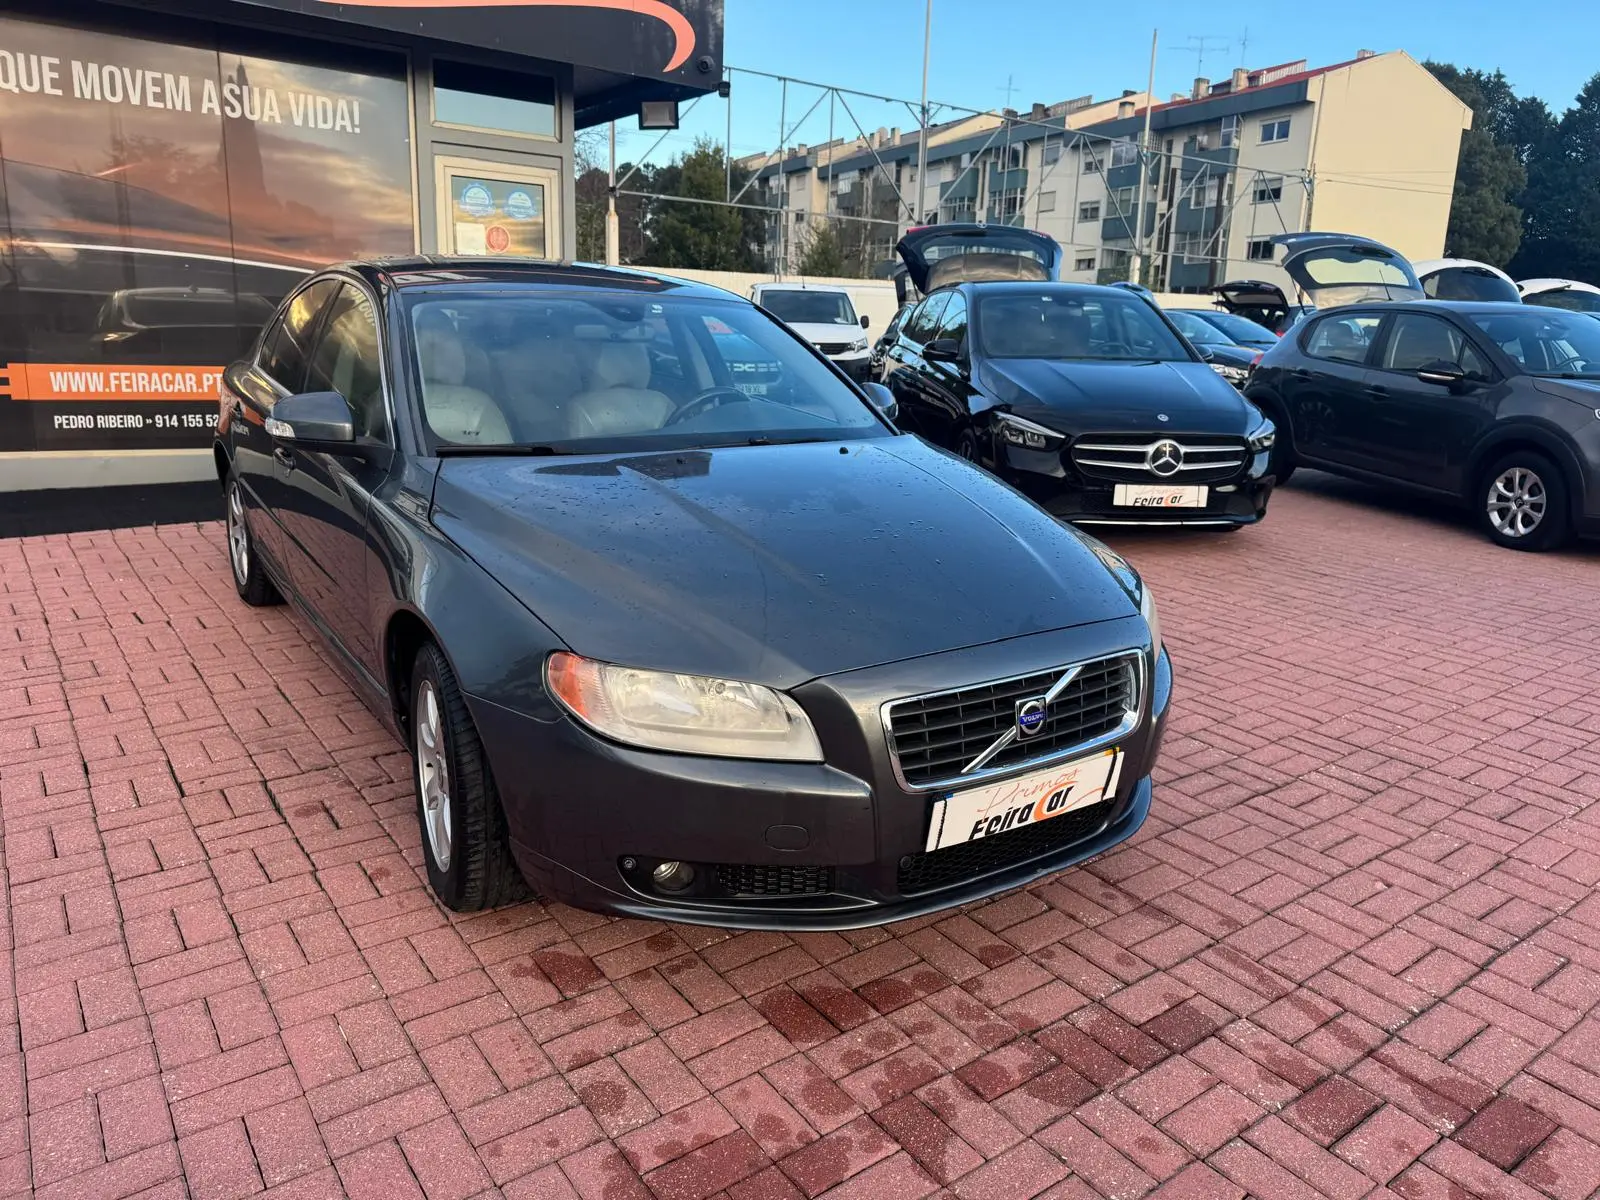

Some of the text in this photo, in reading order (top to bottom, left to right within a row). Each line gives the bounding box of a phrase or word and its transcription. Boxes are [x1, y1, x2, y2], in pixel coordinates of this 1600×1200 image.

[0, 49, 63, 96] QUE
[71, 60, 192, 113] MOVEM
[288, 91, 361, 134] VIDA!
[49, 371, 223, 393] WWW.FEIRACAR.PT
[54, 415, 94, 429] PEDRO
[97, 415, 143, 428] RIBEIRO
[155, 415, 179, 428] 914
[182, 415, 203, 428] 155
